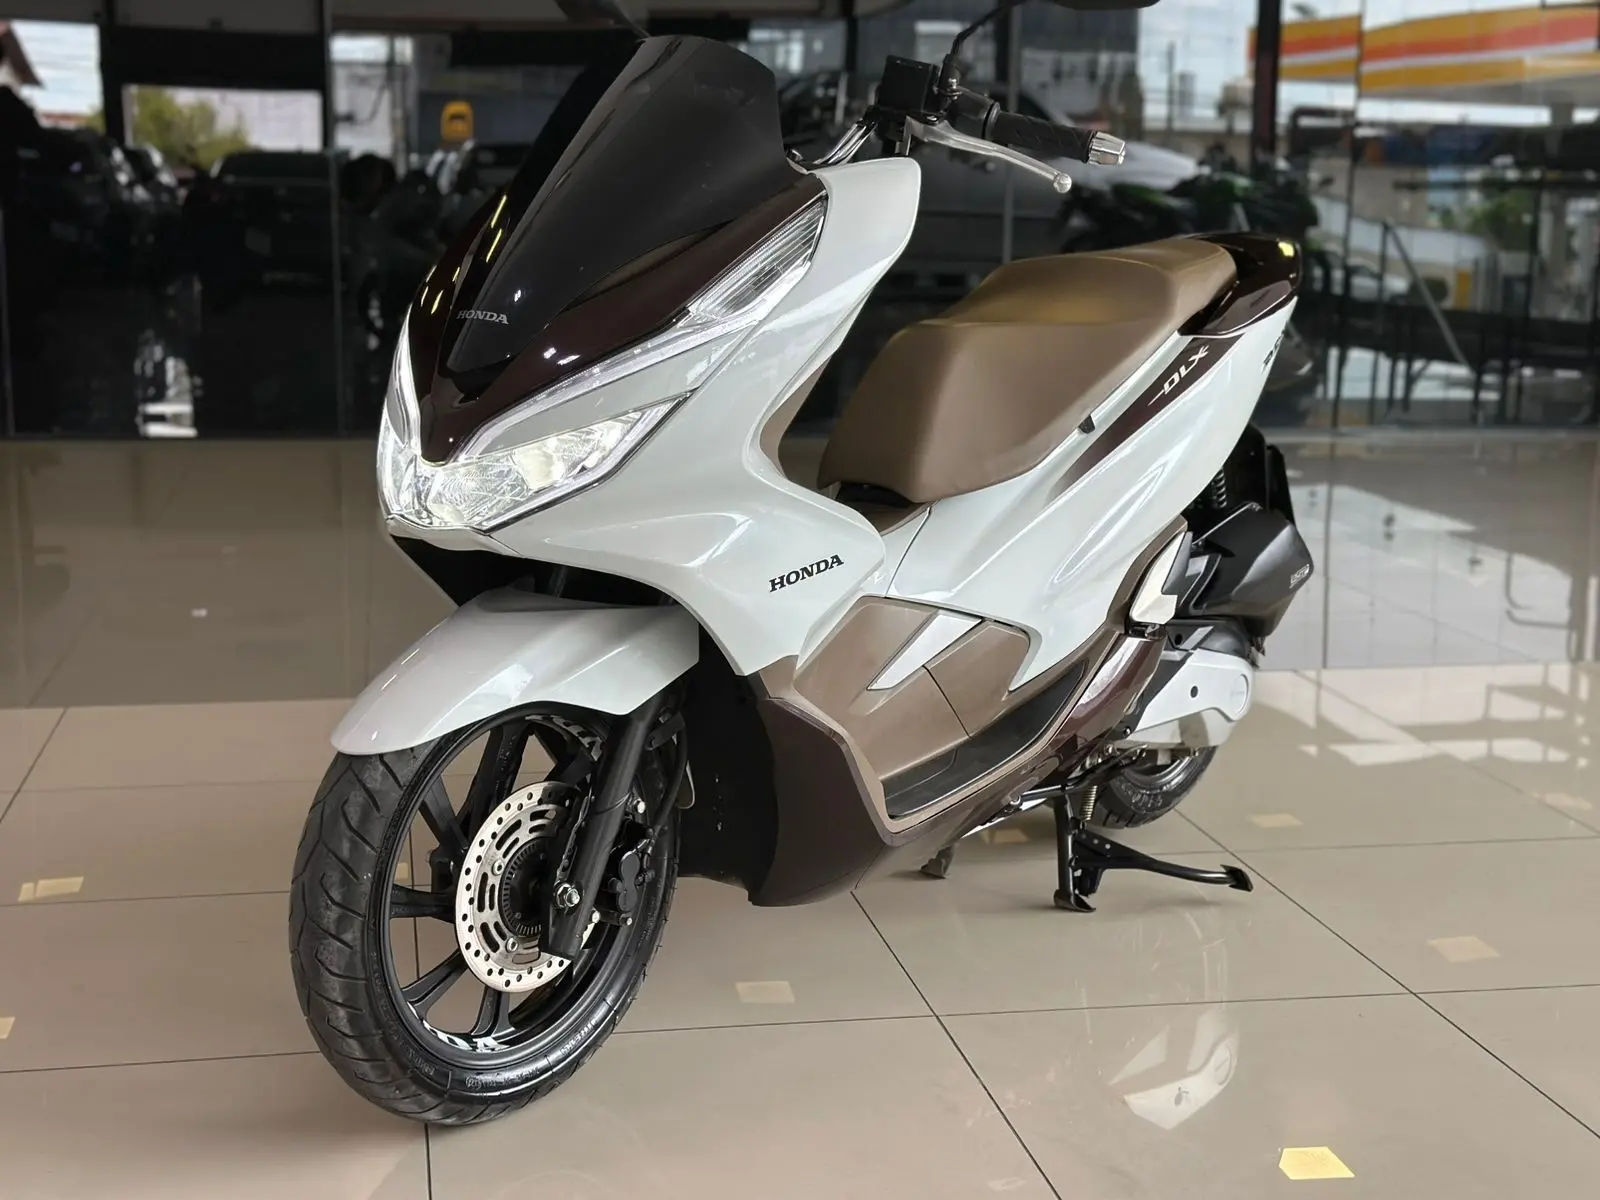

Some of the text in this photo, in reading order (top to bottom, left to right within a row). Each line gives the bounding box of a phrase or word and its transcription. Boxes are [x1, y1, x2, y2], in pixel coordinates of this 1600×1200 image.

[457, 309, 509, 325] HONDA
[1163, 344, 1209, 395] DLX
[768, 554, 844, 593] HONDA
